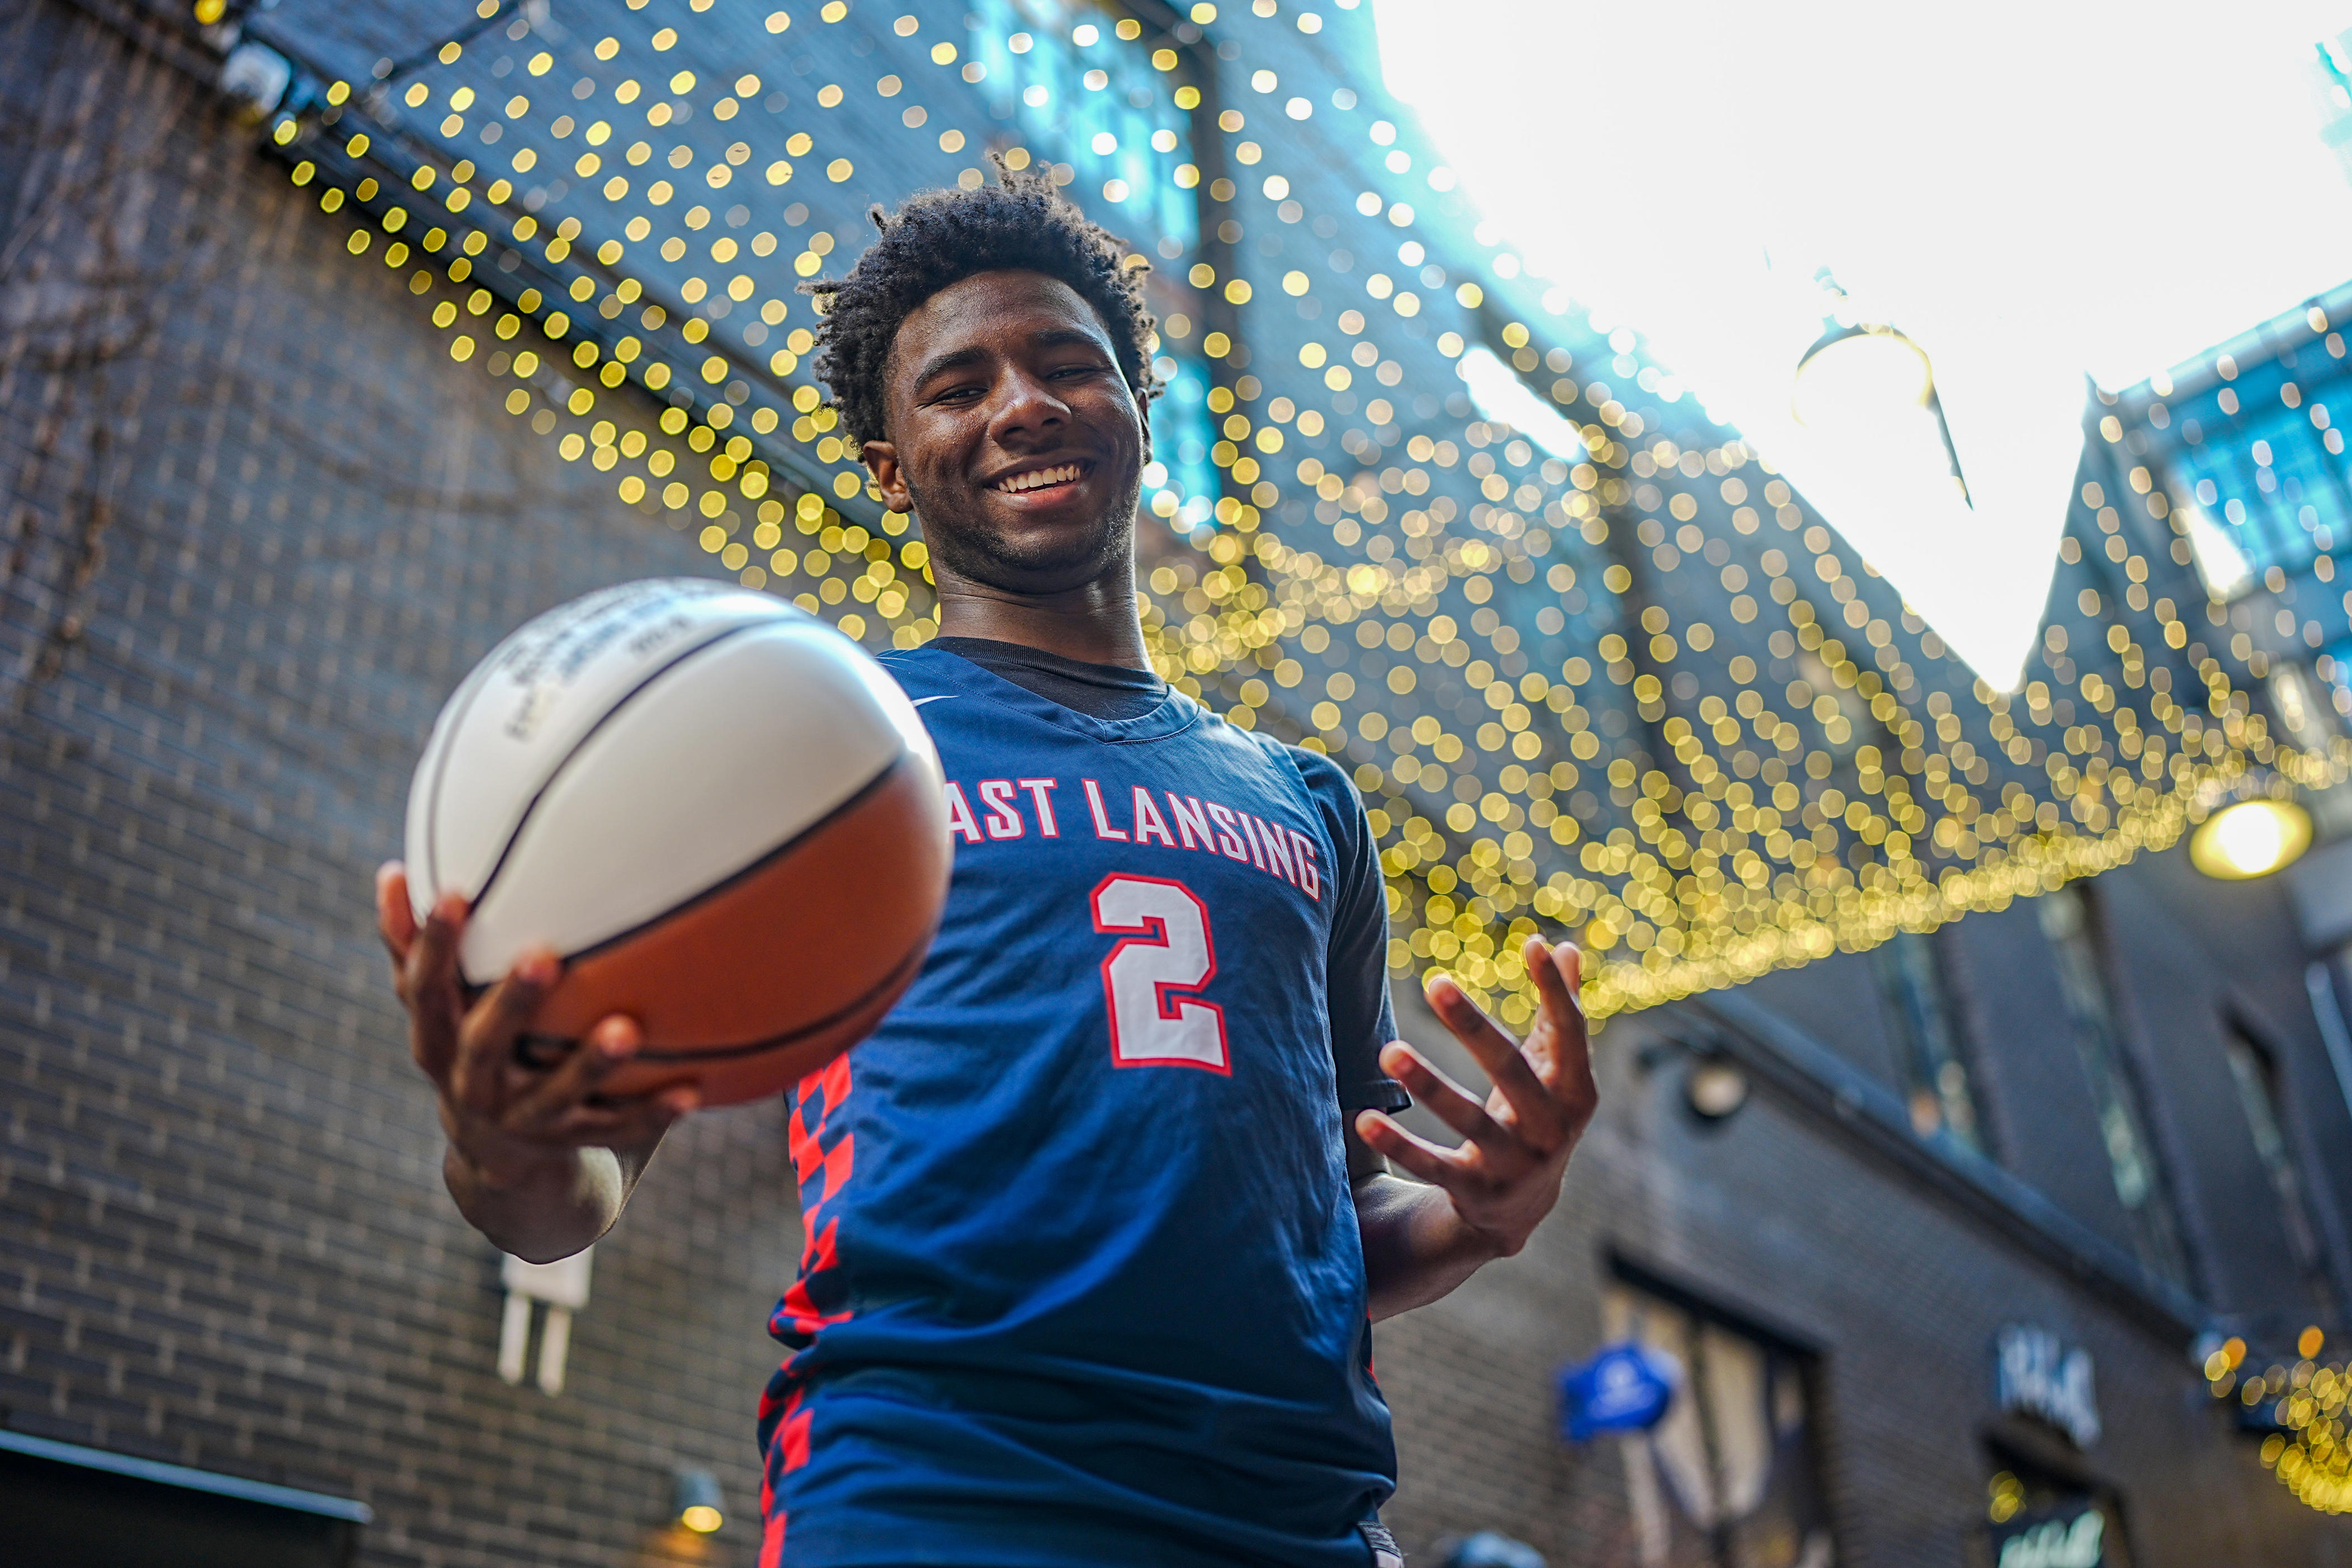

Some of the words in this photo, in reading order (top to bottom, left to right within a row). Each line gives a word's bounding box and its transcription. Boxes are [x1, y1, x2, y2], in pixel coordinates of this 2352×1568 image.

[943, 777, 1060, 844] AST
[1081, 778, 1320, 901] LANSING
[1089, 871, 1231, 1076] 2
